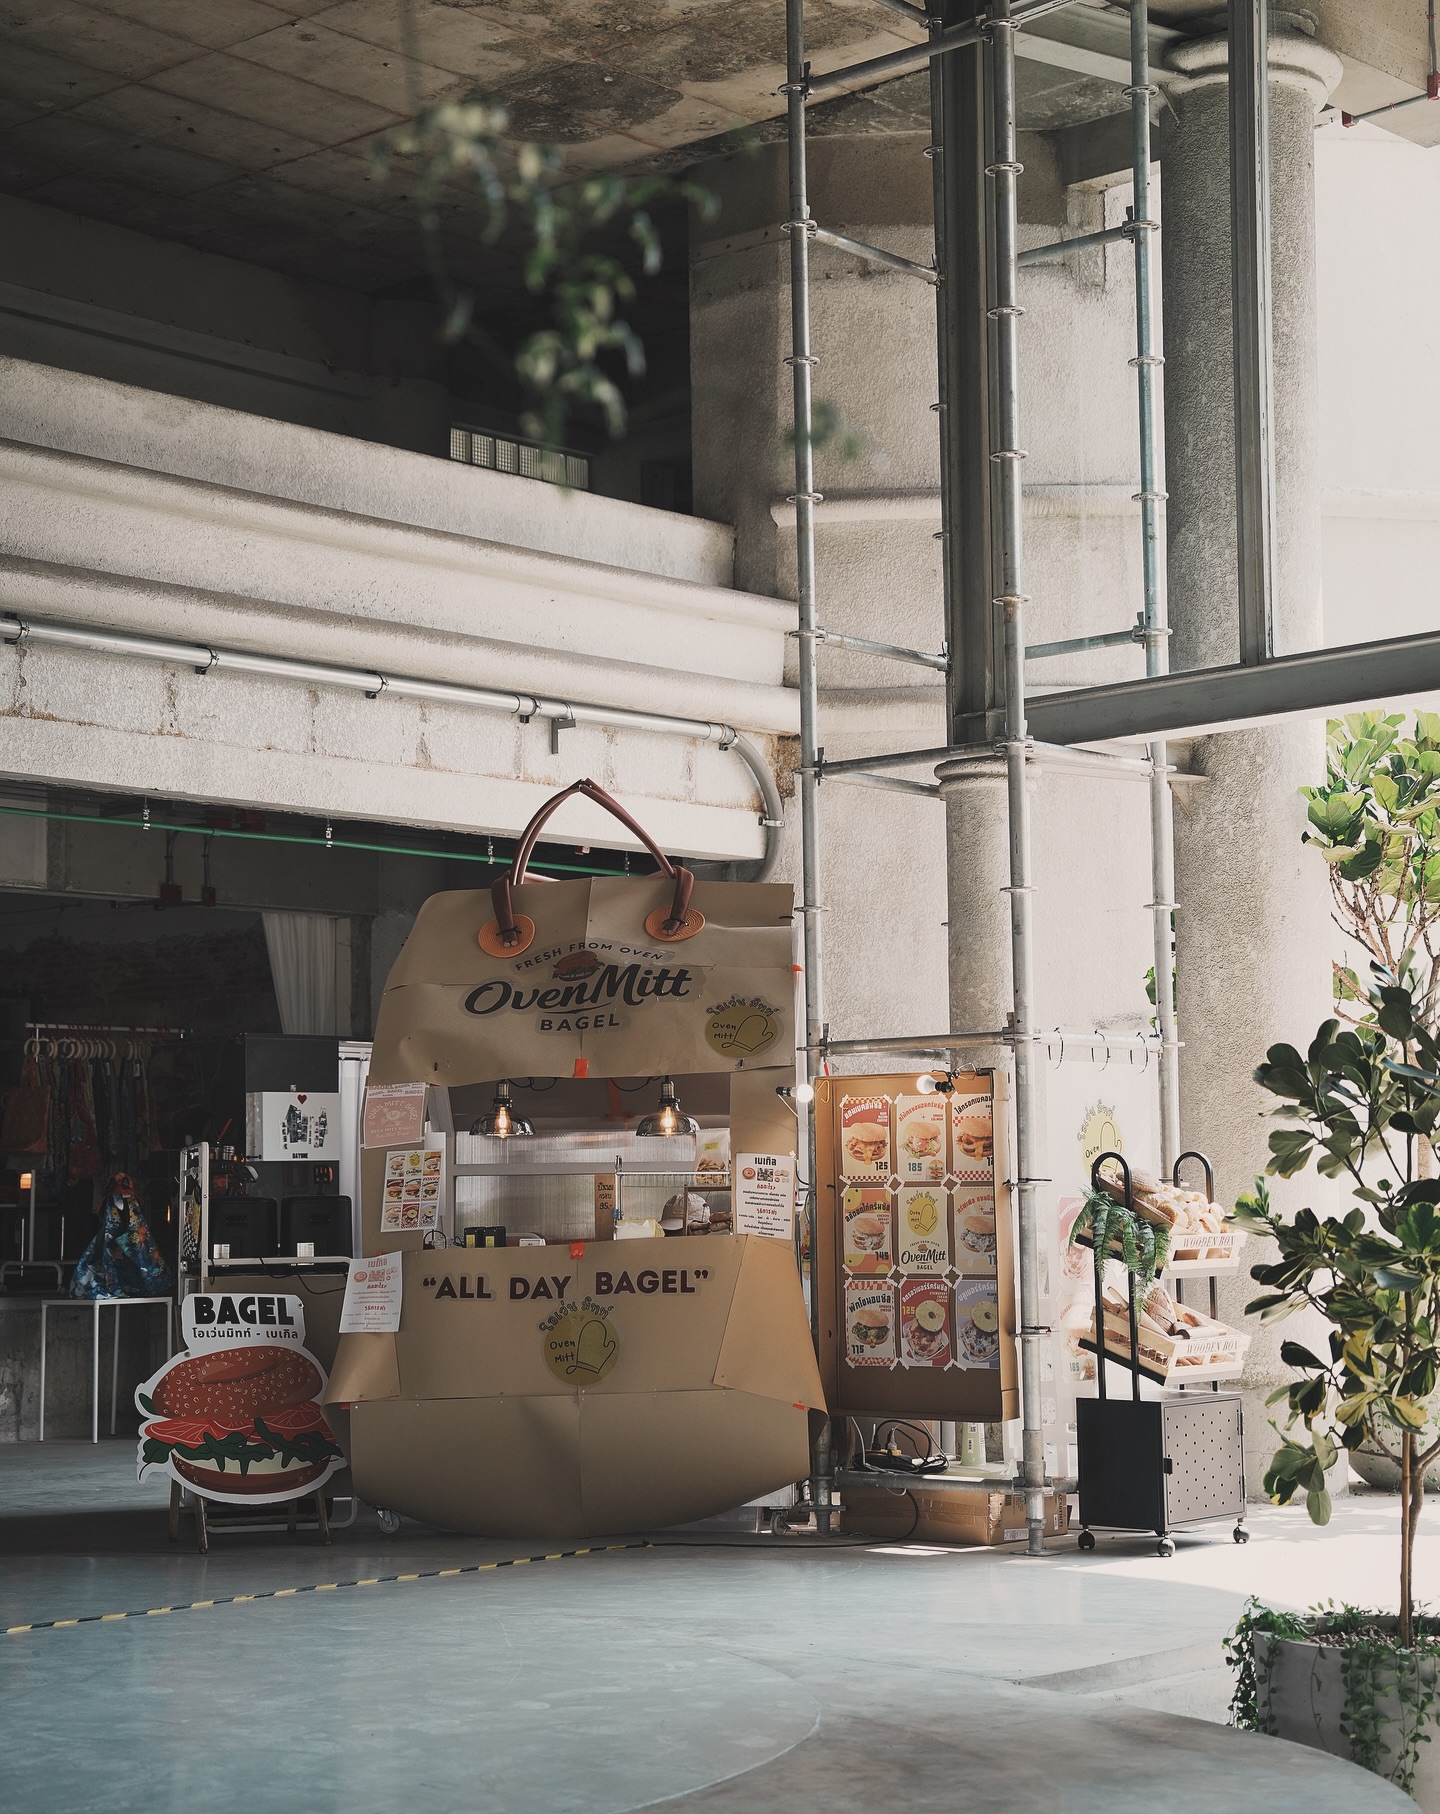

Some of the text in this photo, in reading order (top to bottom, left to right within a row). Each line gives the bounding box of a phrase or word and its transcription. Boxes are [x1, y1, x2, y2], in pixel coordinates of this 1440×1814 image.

[515, 942, 663, 971] FRESH FROM OVEN
[540, 1013, 620, 1032] BAGEL
[712, 1021, 737, 1031] Oven
[713, 1032, 734, 1040] Mitt
[1085, 1145, 1100, 1159] Oven
[875, 1161, 889, 1171] 125
[908, 1162, 923, 1172] 185
[1183, 1235, 1236, 1248] WOODEN BOX
[875, 1251, 889, 1261] 145
[509, 1275, 572, 1300] DAY
[193, 1296, 295, 1326] BAGEL
[902, 1305, 916, 1316] 125
[192, 1326, 251, 1339] โอเว่นมิทท์
[265, 1328, 299, 1340] เบเกิล
[549, 1339, 576, 1351] Oven
[851, 1344, 865, 1355] 115
[1186, 1340, 1239, 1354] WOODEN BOX
[554, 1352, 575, 1364] Mitt
